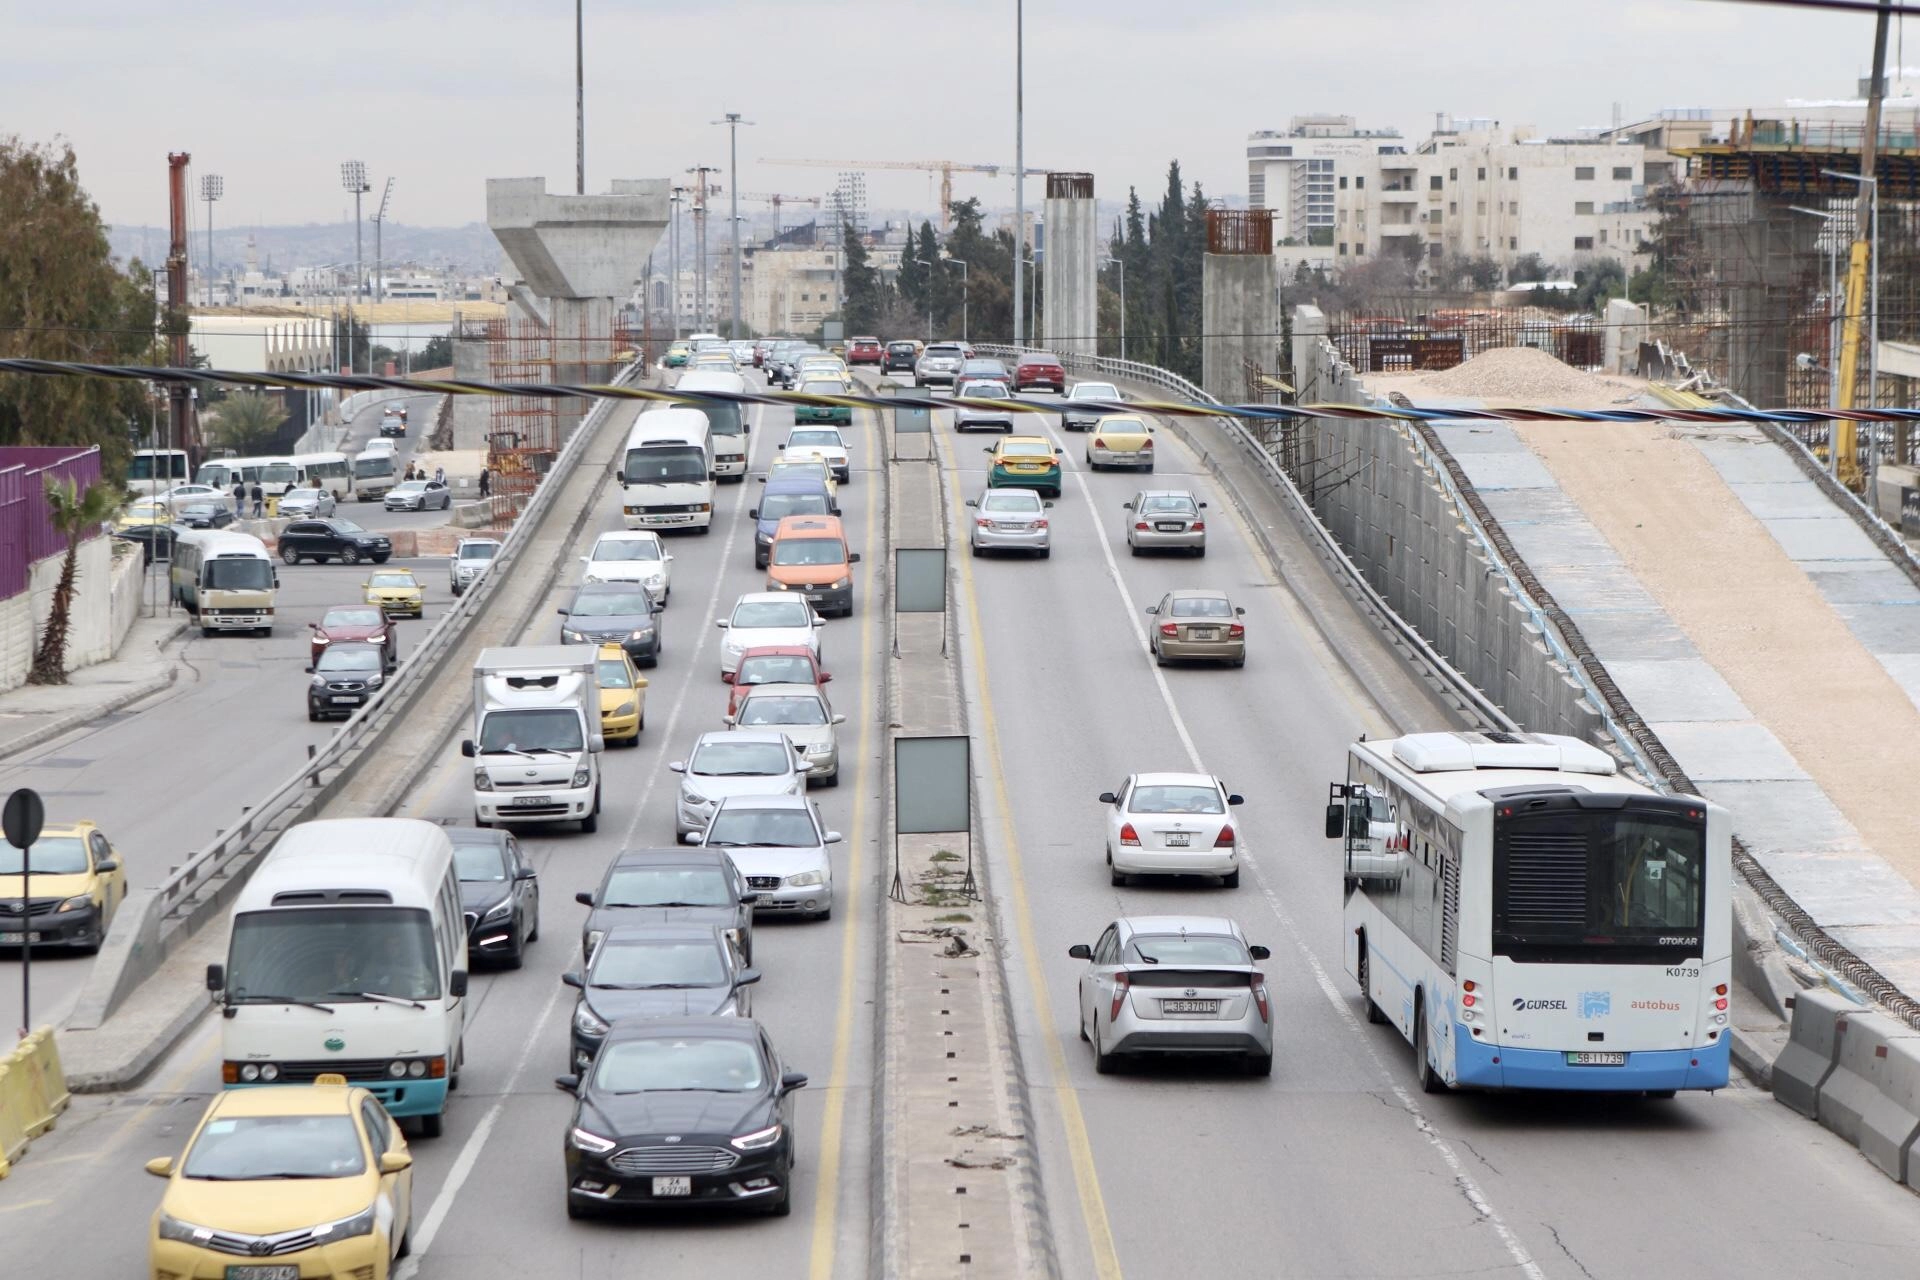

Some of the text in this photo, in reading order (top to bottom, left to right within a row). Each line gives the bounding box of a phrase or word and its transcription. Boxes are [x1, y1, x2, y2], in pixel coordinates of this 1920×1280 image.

[1658, 937, 1698, 945] OTOKAR
[1666, 967, 1699, 977] K0739
[1527, 999, 1567, 1010] GÜRSEL
[1631, 1000, 1680, 1011] autobus
